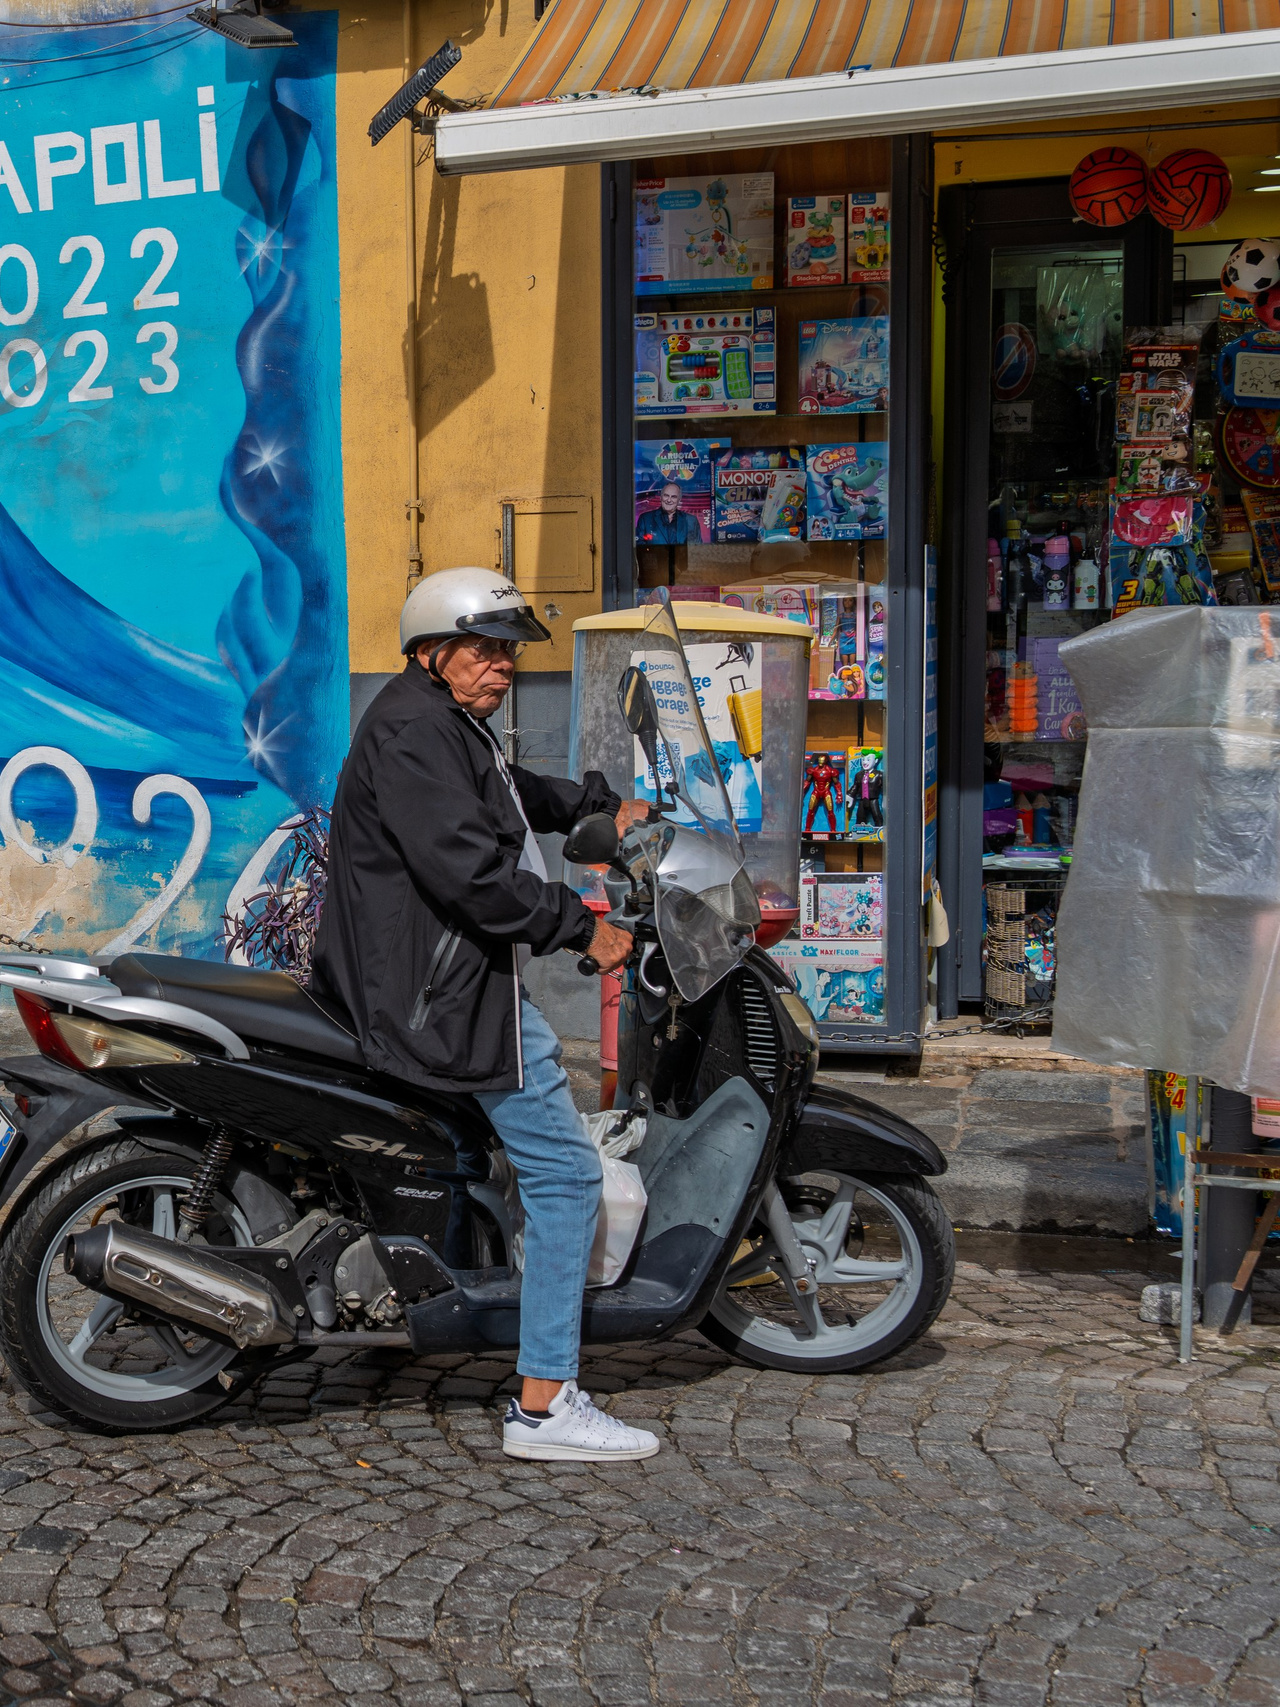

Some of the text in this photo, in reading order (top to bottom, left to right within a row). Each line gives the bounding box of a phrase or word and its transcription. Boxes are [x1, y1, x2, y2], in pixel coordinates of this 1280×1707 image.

[803, 326, 816, 335] LEGO
[801, 400, 817, 412] 4+
[661, 463, 695, 471] FORTUNA
[721, 472, 771, 485] MONOP
[1119, 579, 1139, 600] 3
[649, 662, 675, 671] bounce
[810, 846, 818, 854] 6+
[1165, 1072, 1177, 1088] 2
[331, 1134, 407, 1156] SH
[393, 1186, 444, 1198] PGM-FI
